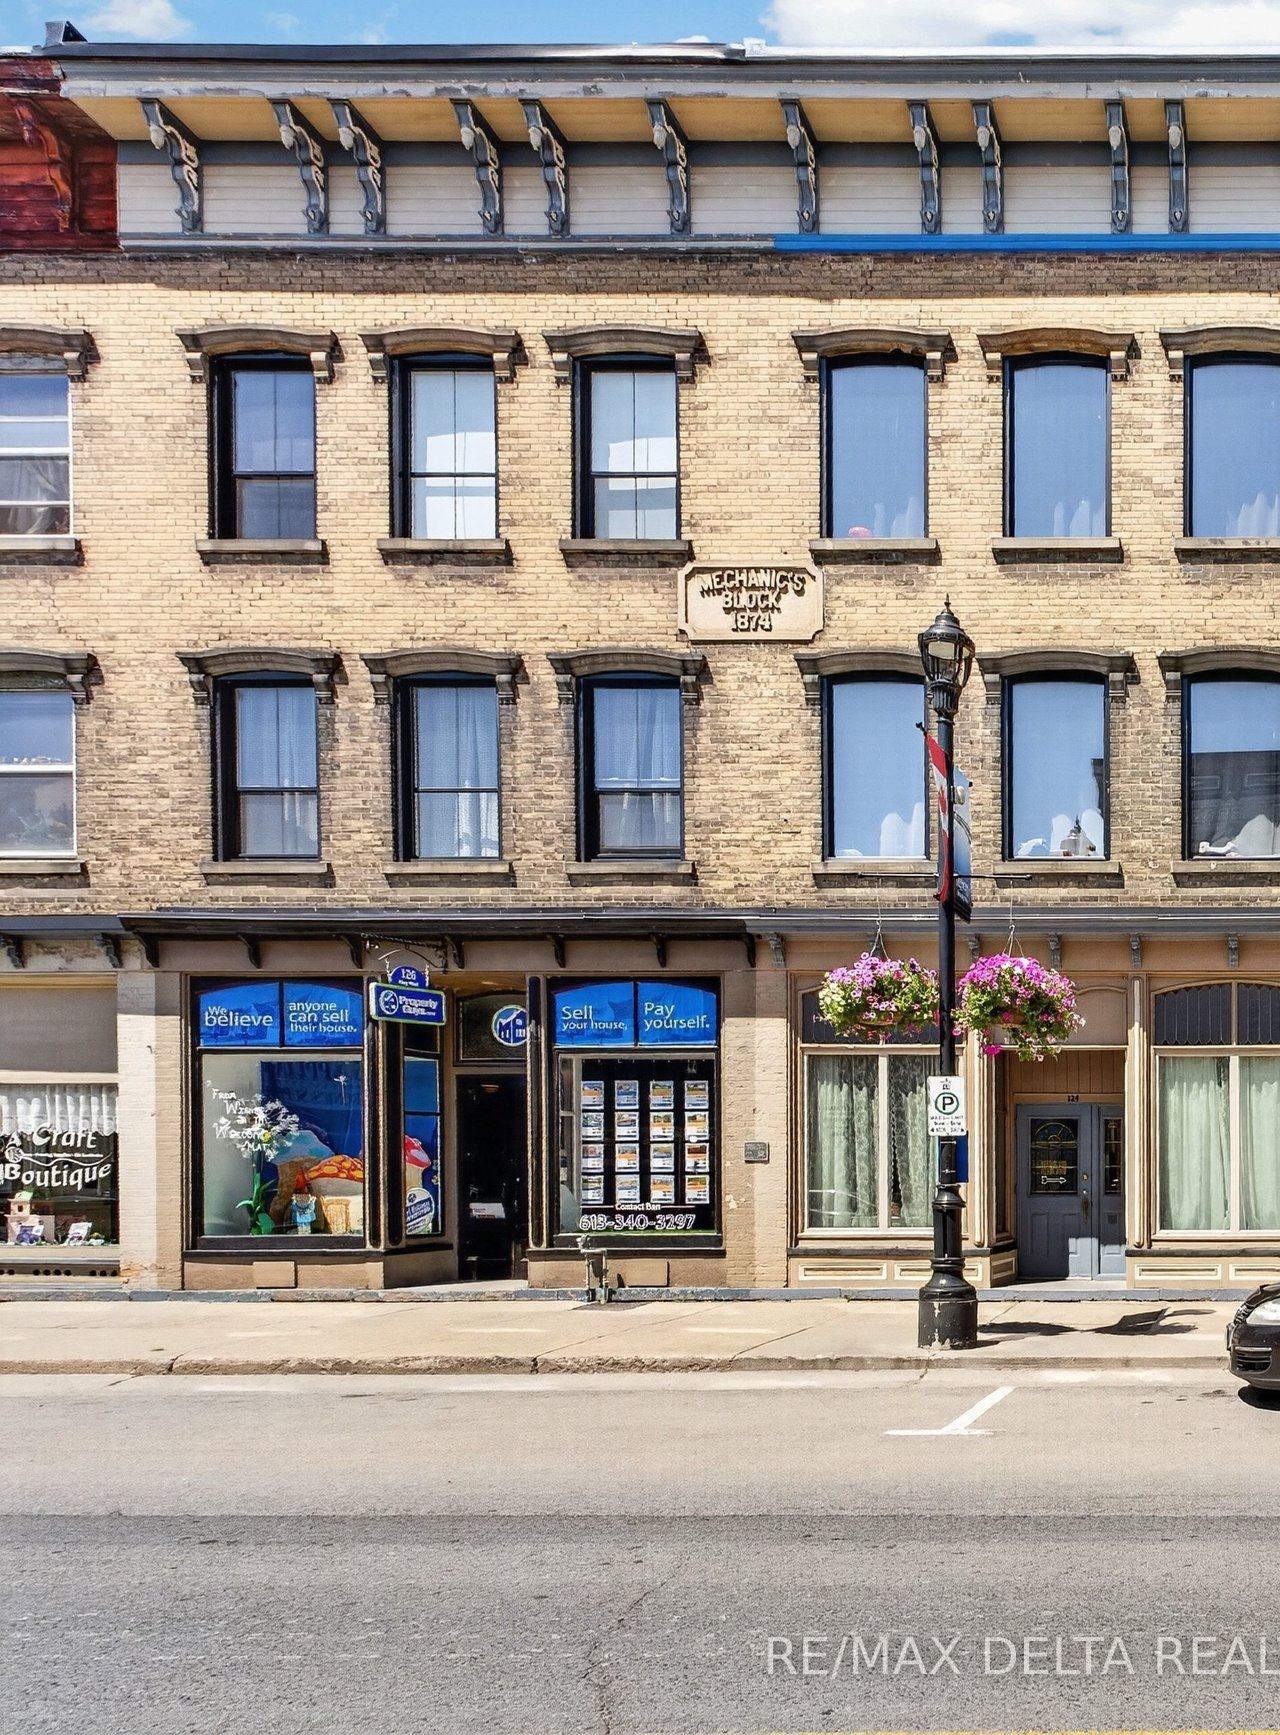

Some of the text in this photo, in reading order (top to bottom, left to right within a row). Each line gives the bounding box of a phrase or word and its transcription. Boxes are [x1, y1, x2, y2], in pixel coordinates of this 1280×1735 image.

[699, 569, 807, 595] MECHANIC'S
[722, 590, 781, 610] BLOCK
[732, 612, 773, 631] 1874
[208, 1006, 227, 1016] We
[289, 1002, 337, 1015] anyone
[289, 1010, 349, 1023] can sell
[561, 1006, 593, 1020] Sell
[644, 1002, 675, 1019] Pay
[204, 1010, 273, 1027] believe
[562, 1021, 587, 1031] your
[644, 1015, 710, 1032] yourself.
[290, 1023, 357, 1033] their house.
[33, 1122, 97, 1148] Craft
[5, 1163, 112, 1191] Boutique
[615, 1202, 645, 1211] Contact
[579, 1213, 696, 1231] 613-340-3297
